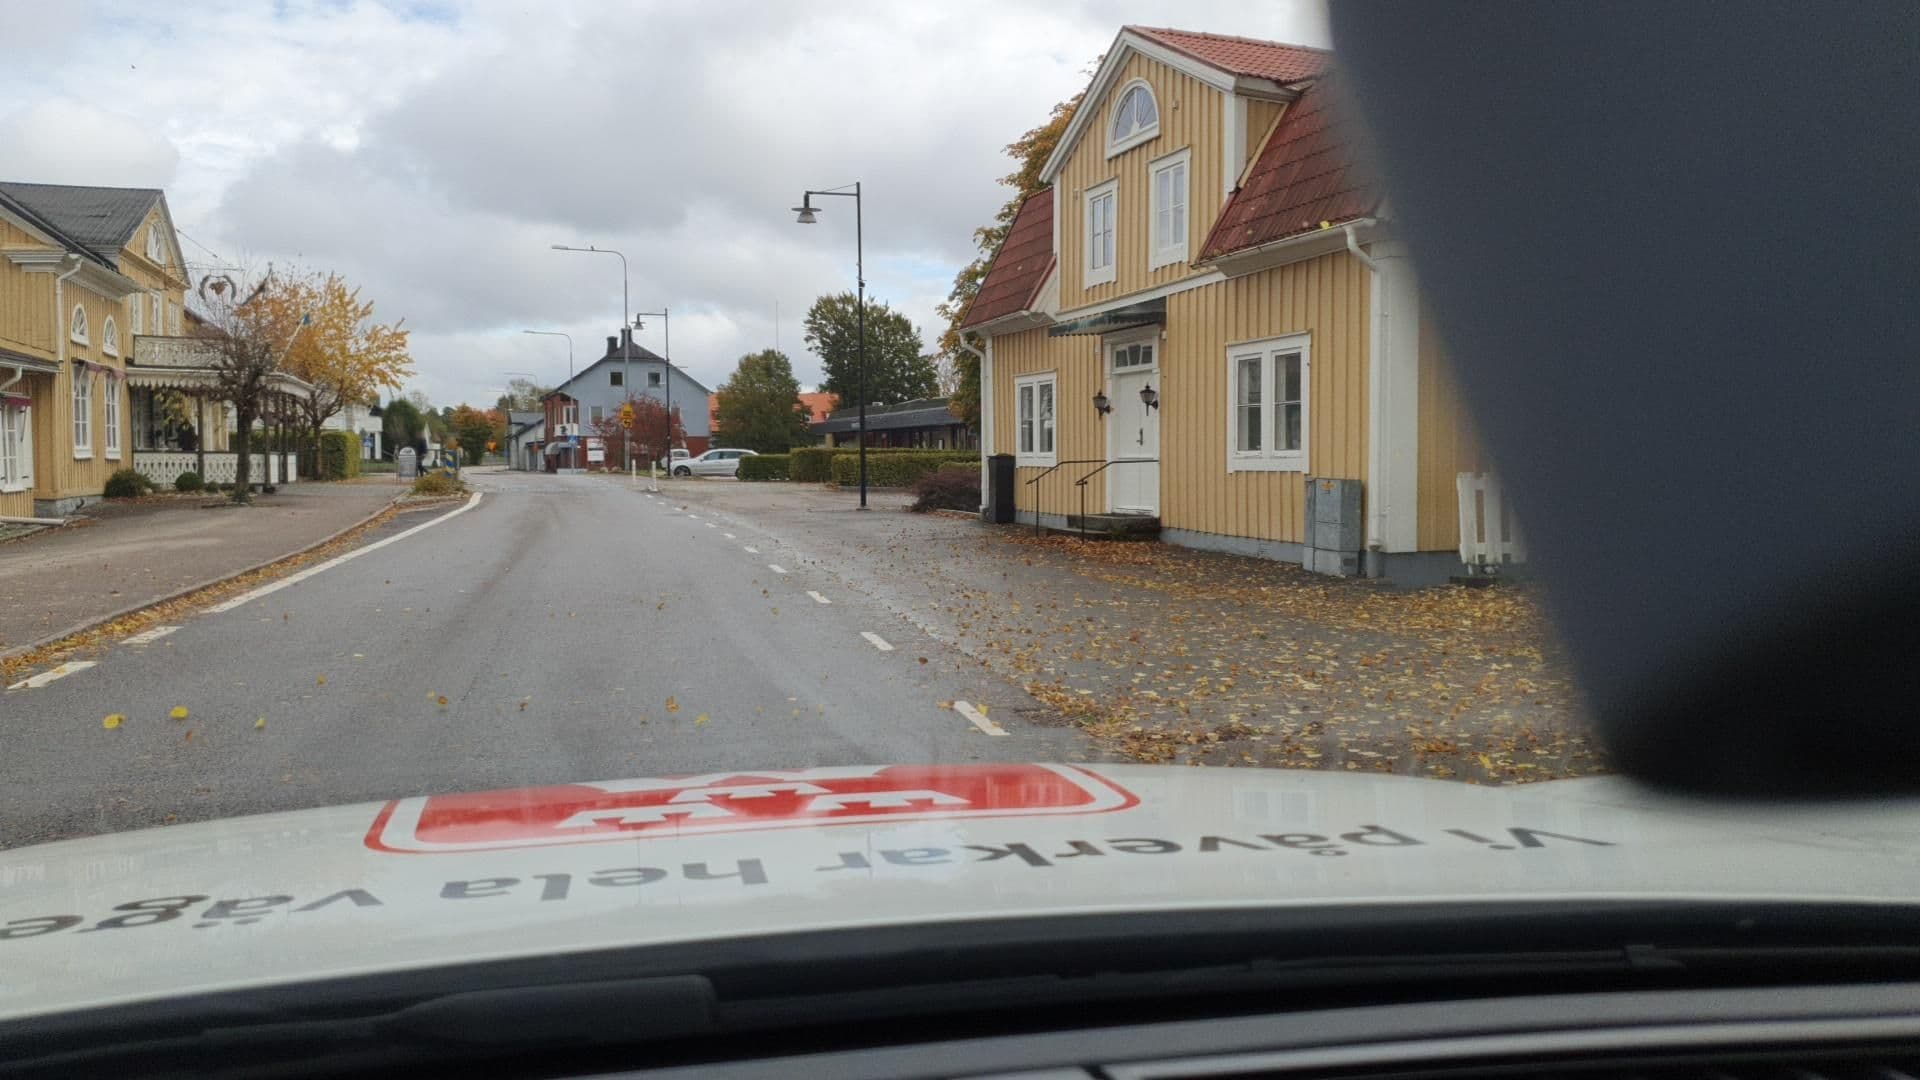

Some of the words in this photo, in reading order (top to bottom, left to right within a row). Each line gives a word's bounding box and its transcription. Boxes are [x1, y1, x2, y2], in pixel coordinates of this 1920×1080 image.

[815, 825, 1429, 872] påverkar
[1442, 827, 1617, 851] Vi
[440, 858, 769, 902] hela
